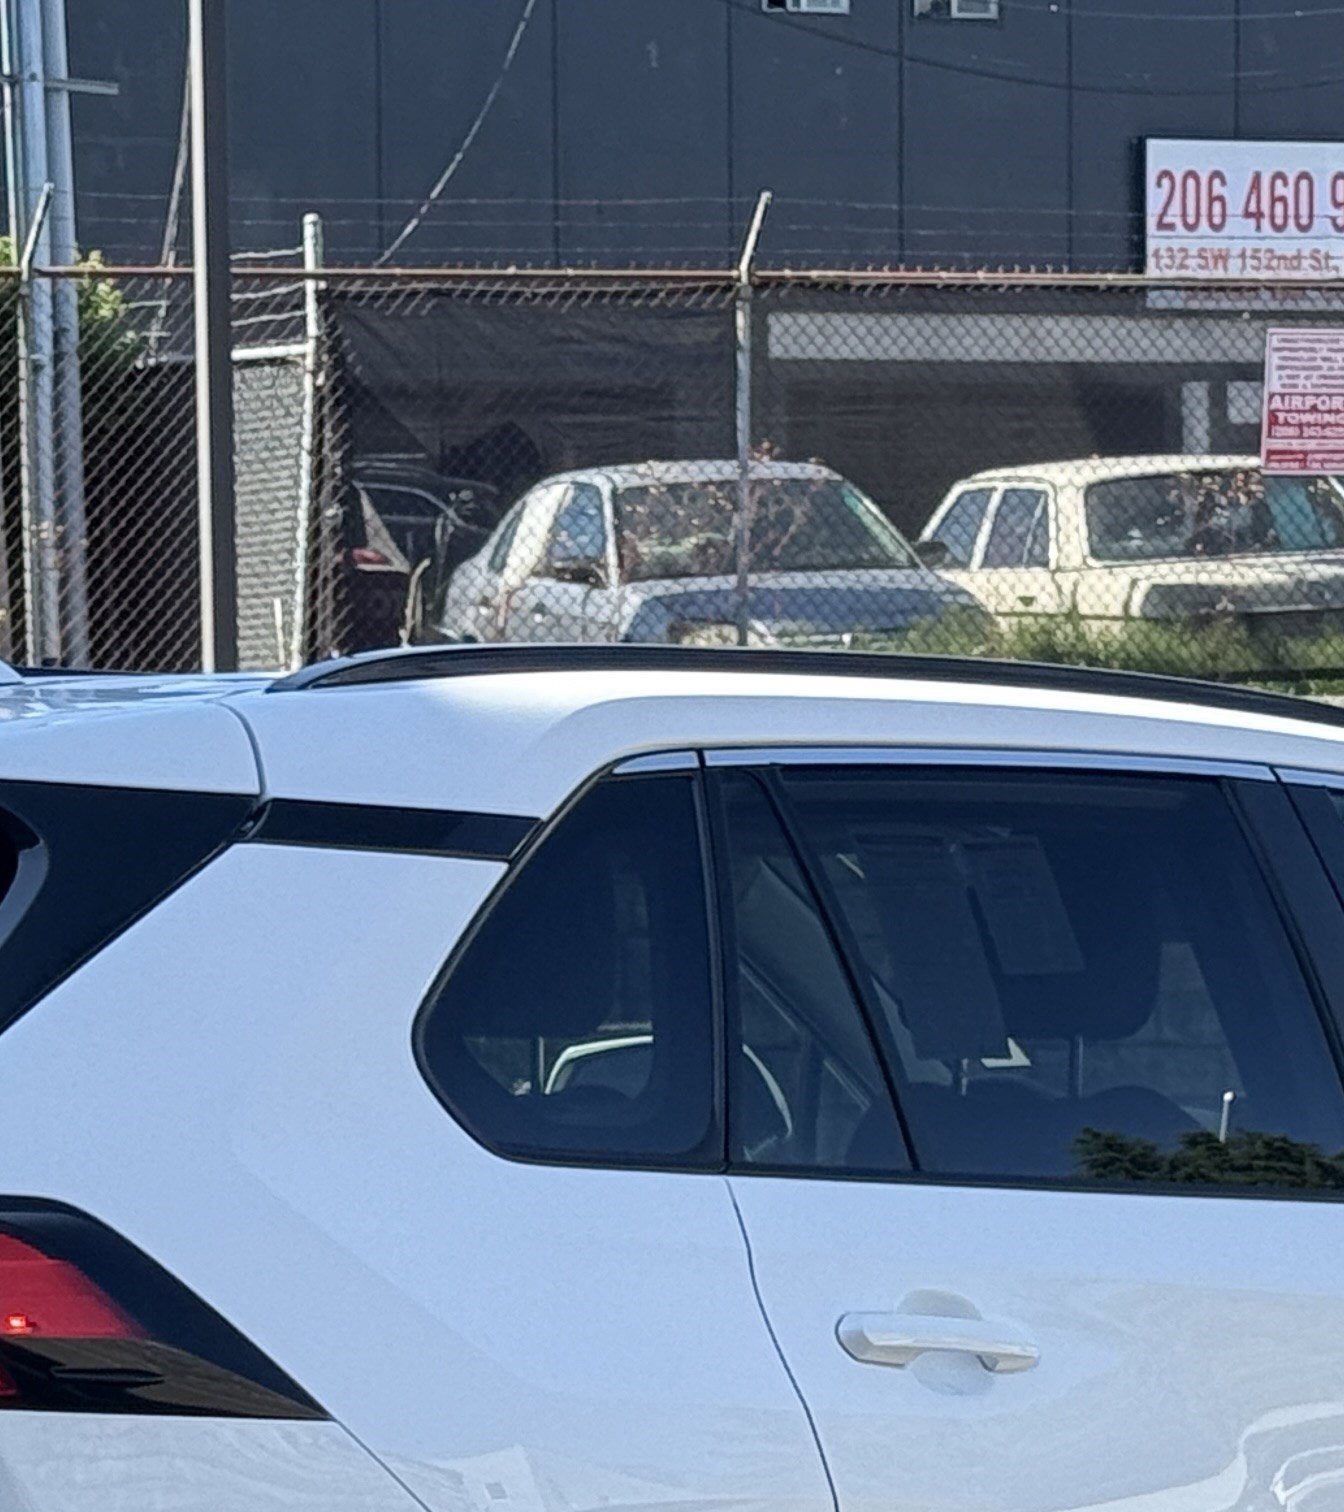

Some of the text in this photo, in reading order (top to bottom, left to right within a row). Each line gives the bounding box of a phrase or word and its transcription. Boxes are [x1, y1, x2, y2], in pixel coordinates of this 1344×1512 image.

[1155, 169, 1227, 233] 206
[1242, 170, 1315, 233] 460
[1152, 247, 1191, 271] 132
[1196, 248, 1229, 272] SW
[1240, 247, 1301, 272] 152nd
